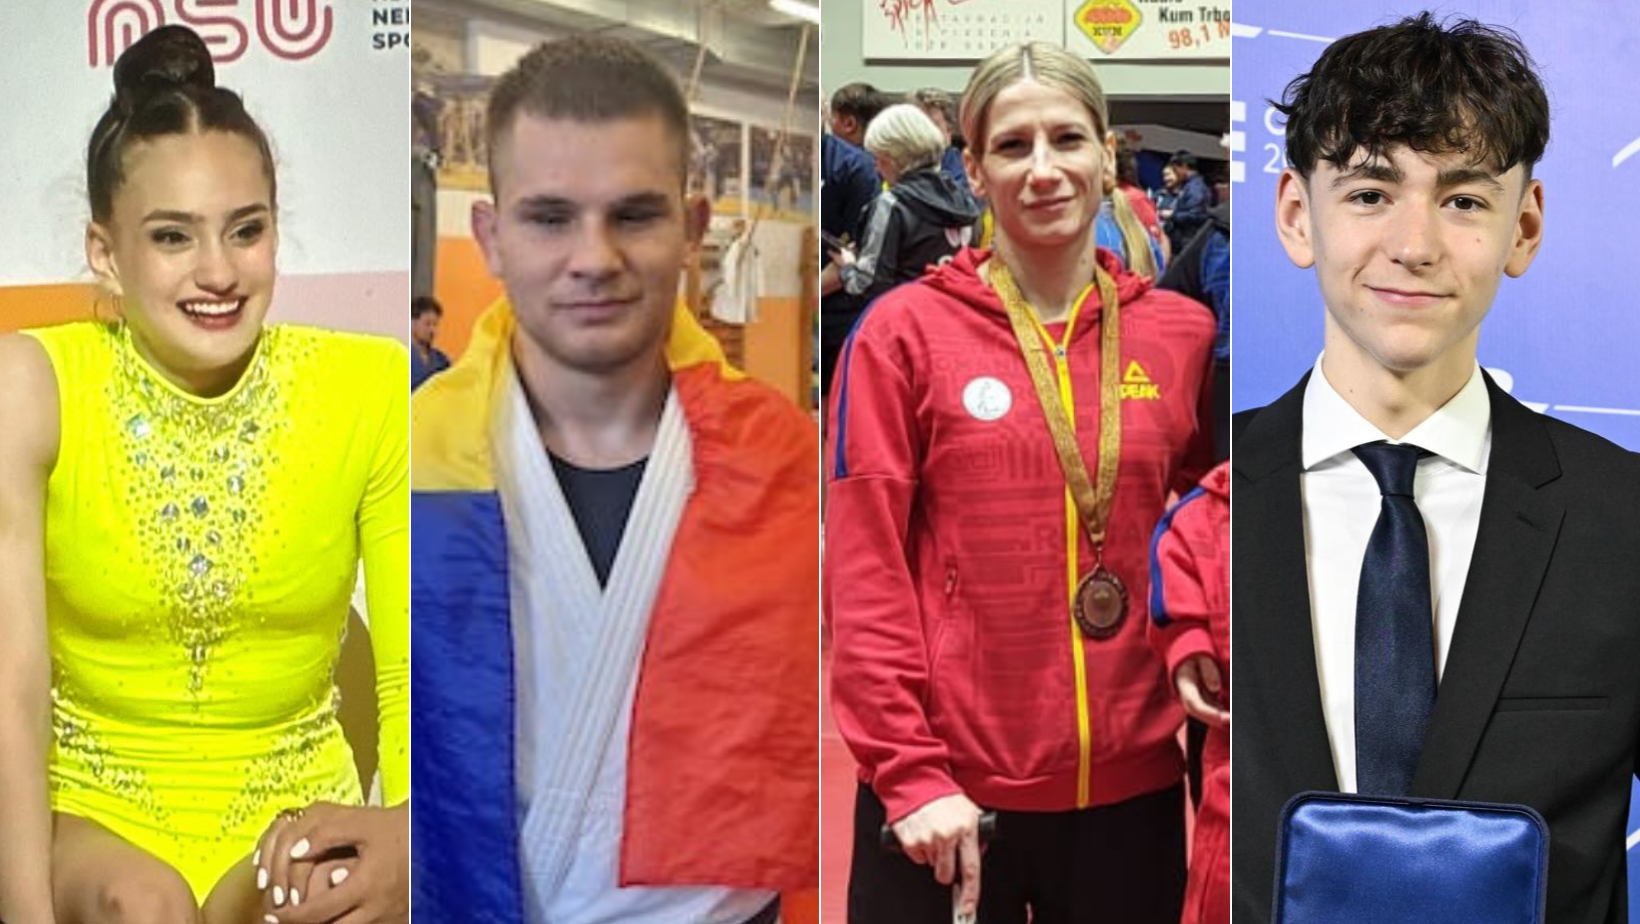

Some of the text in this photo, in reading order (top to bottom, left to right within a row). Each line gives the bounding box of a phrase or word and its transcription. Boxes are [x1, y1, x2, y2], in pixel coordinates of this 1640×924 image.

[1159, 6, 1193, 22] Kum
[1168, 23, 1211, 49] 98,1
[1118, 383, 1161, 400] PEAK
